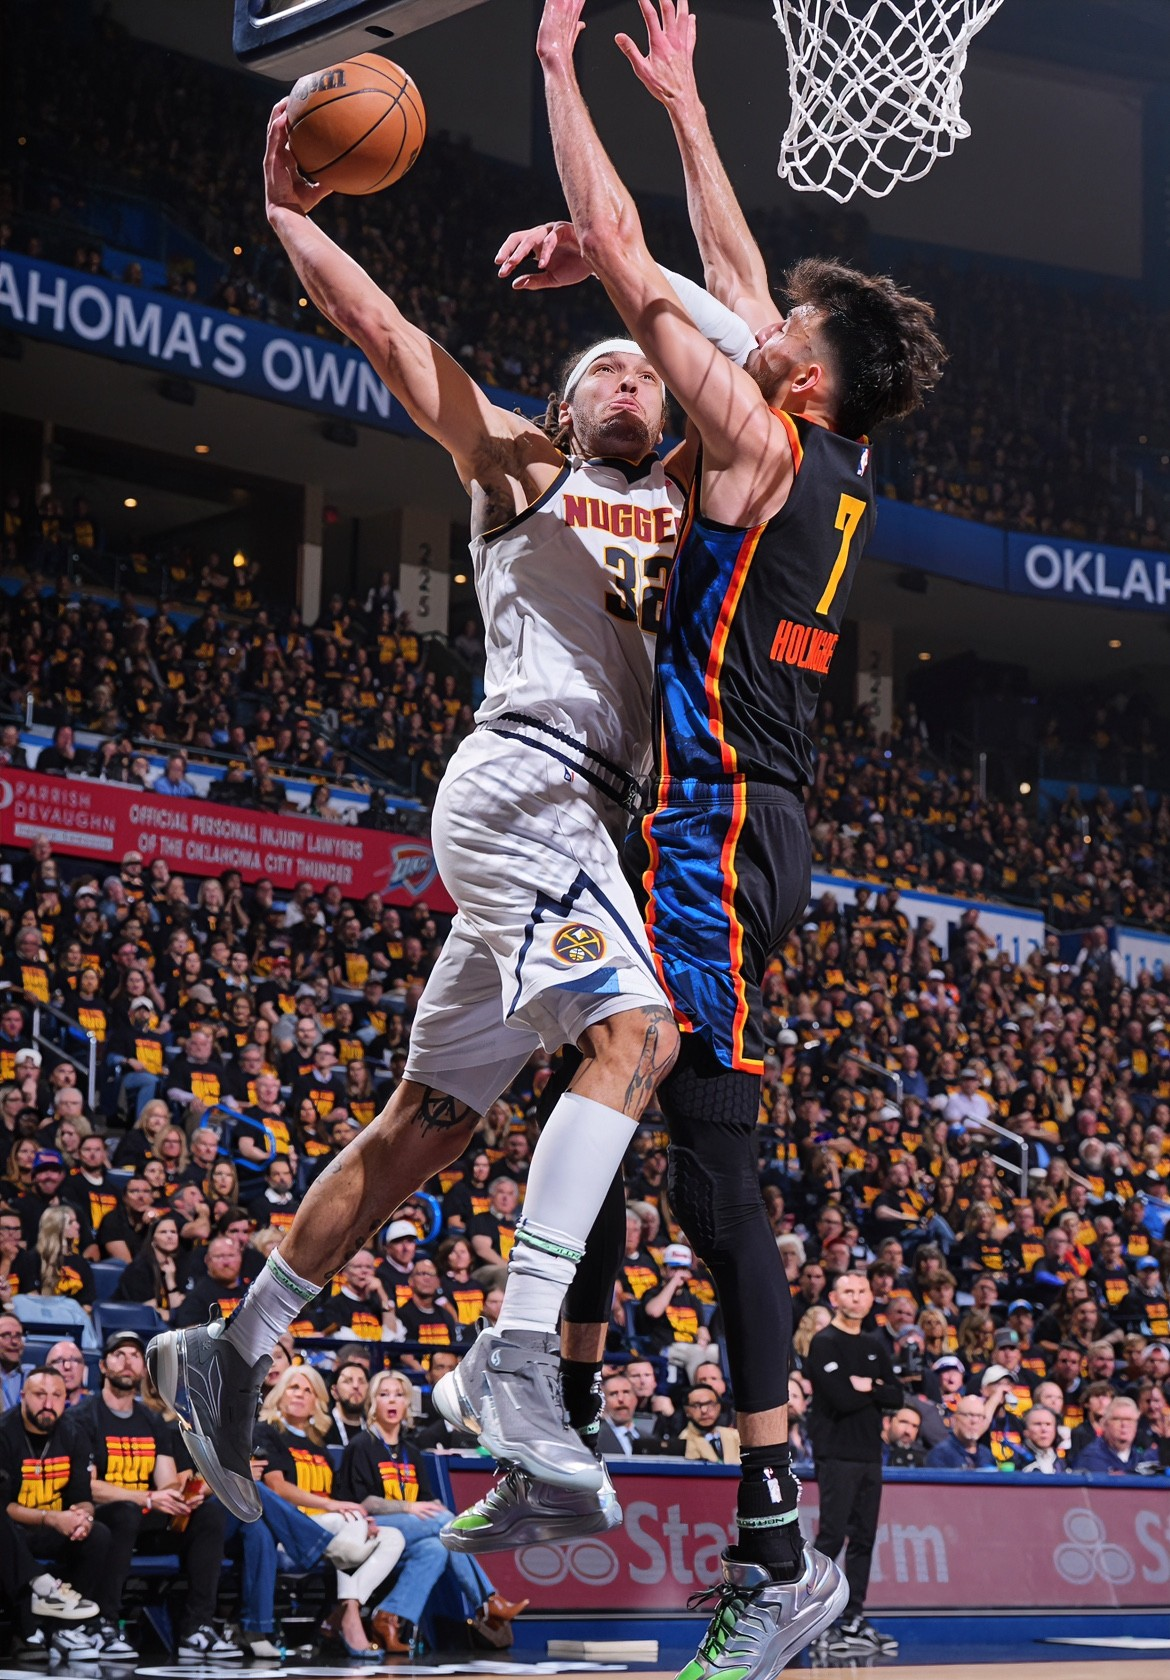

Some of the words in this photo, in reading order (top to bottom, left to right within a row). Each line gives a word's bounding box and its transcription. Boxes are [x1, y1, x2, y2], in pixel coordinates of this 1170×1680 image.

[262, 338, 391, 419] OWN
[563, 494, 681, 545] NUGGE
[815, 493, 867, 616] 7
[603, 546, 673, 637] 32
[14, 801, 116, 832] DEVAUGHN
[129, 804, 189, 833] OFFICIAL
[191, 814, 257, 844] PERSONAL
[260, 825, 305, 851] INJURY
[307, 833, 364, 860] LAWYERS
[138, 832, 157, 853] OF
[160, 835, 184, 858] THE
[186, 840, 261, 870] OKLAHOMA
[264, 853, 293, 876] CITY
[297, 858, 353, 885] THUNDER
